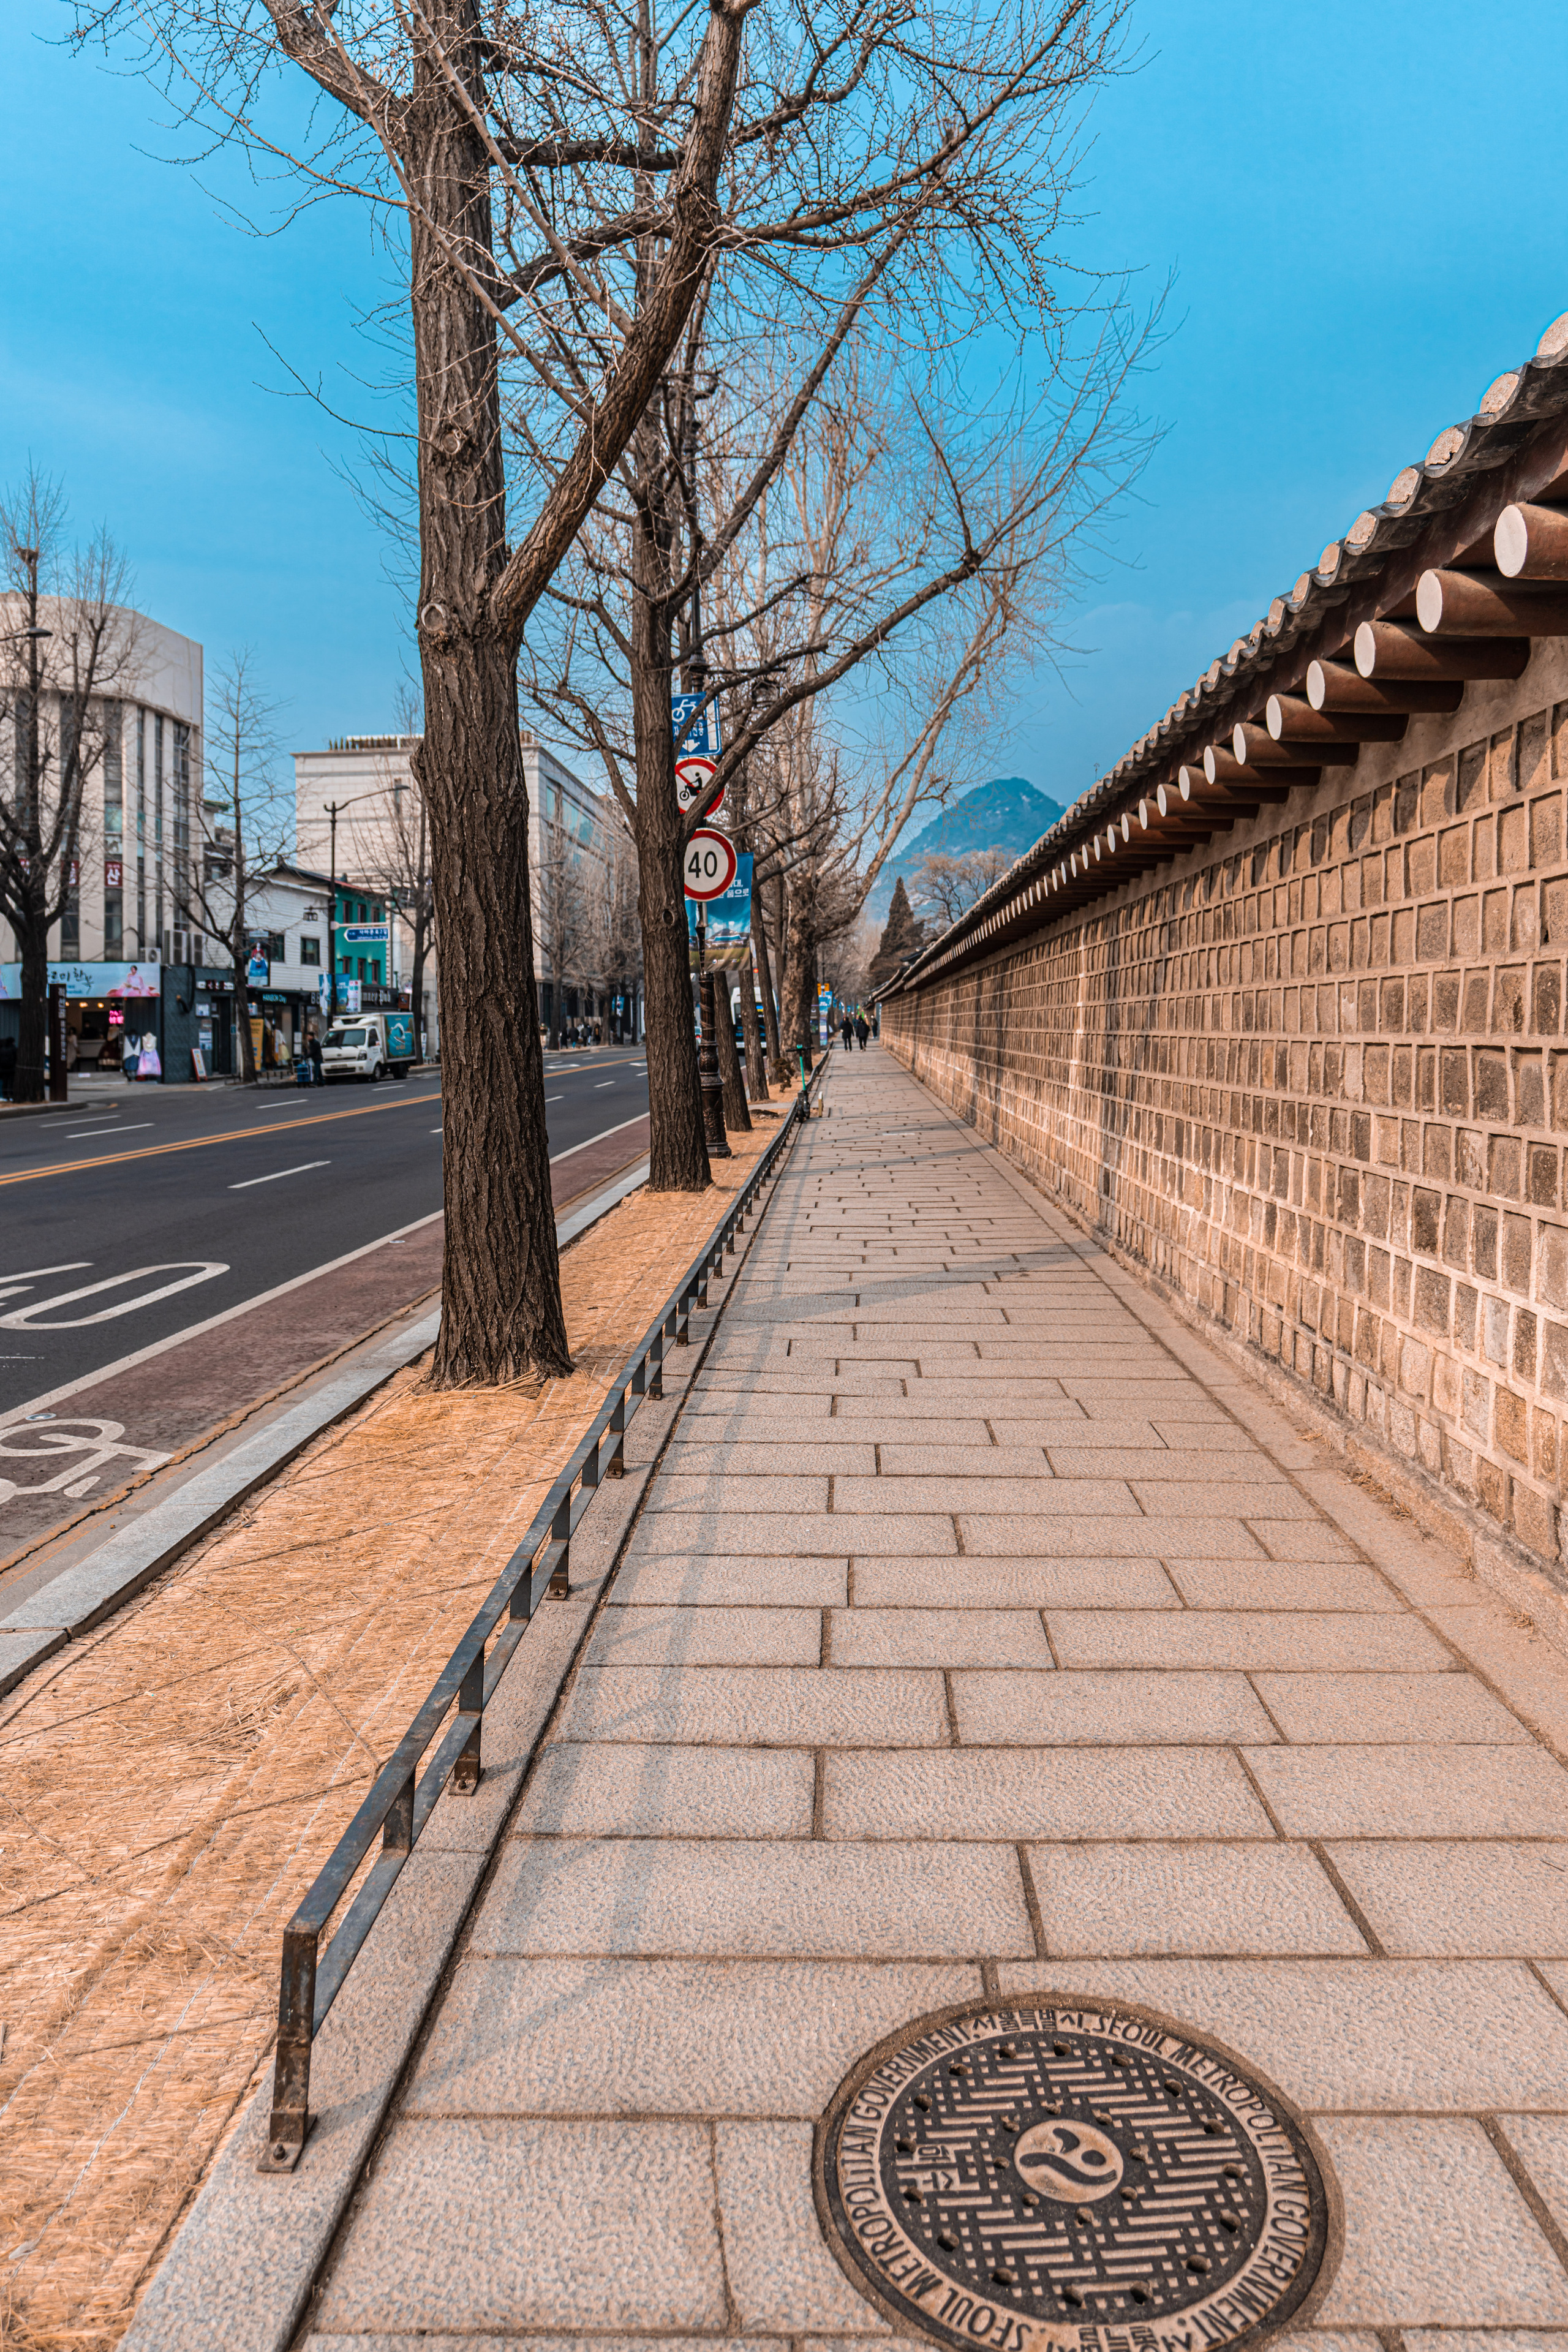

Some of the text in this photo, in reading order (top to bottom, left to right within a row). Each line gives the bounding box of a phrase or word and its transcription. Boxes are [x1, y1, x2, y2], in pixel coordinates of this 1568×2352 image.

[674, 722, 704, 737] 자전용
[688, 850, 717, 878] 40
[727, 889, 749, 898] 품으로
[1093, 2015, 1169, 2056] SEOUL
[1169, 2044, 1308, 2191] METROPOLITAN
[840, 2124, 943, 2301] METROPOLITAN
[937, 2288, 1033, 2352] SEOUL
